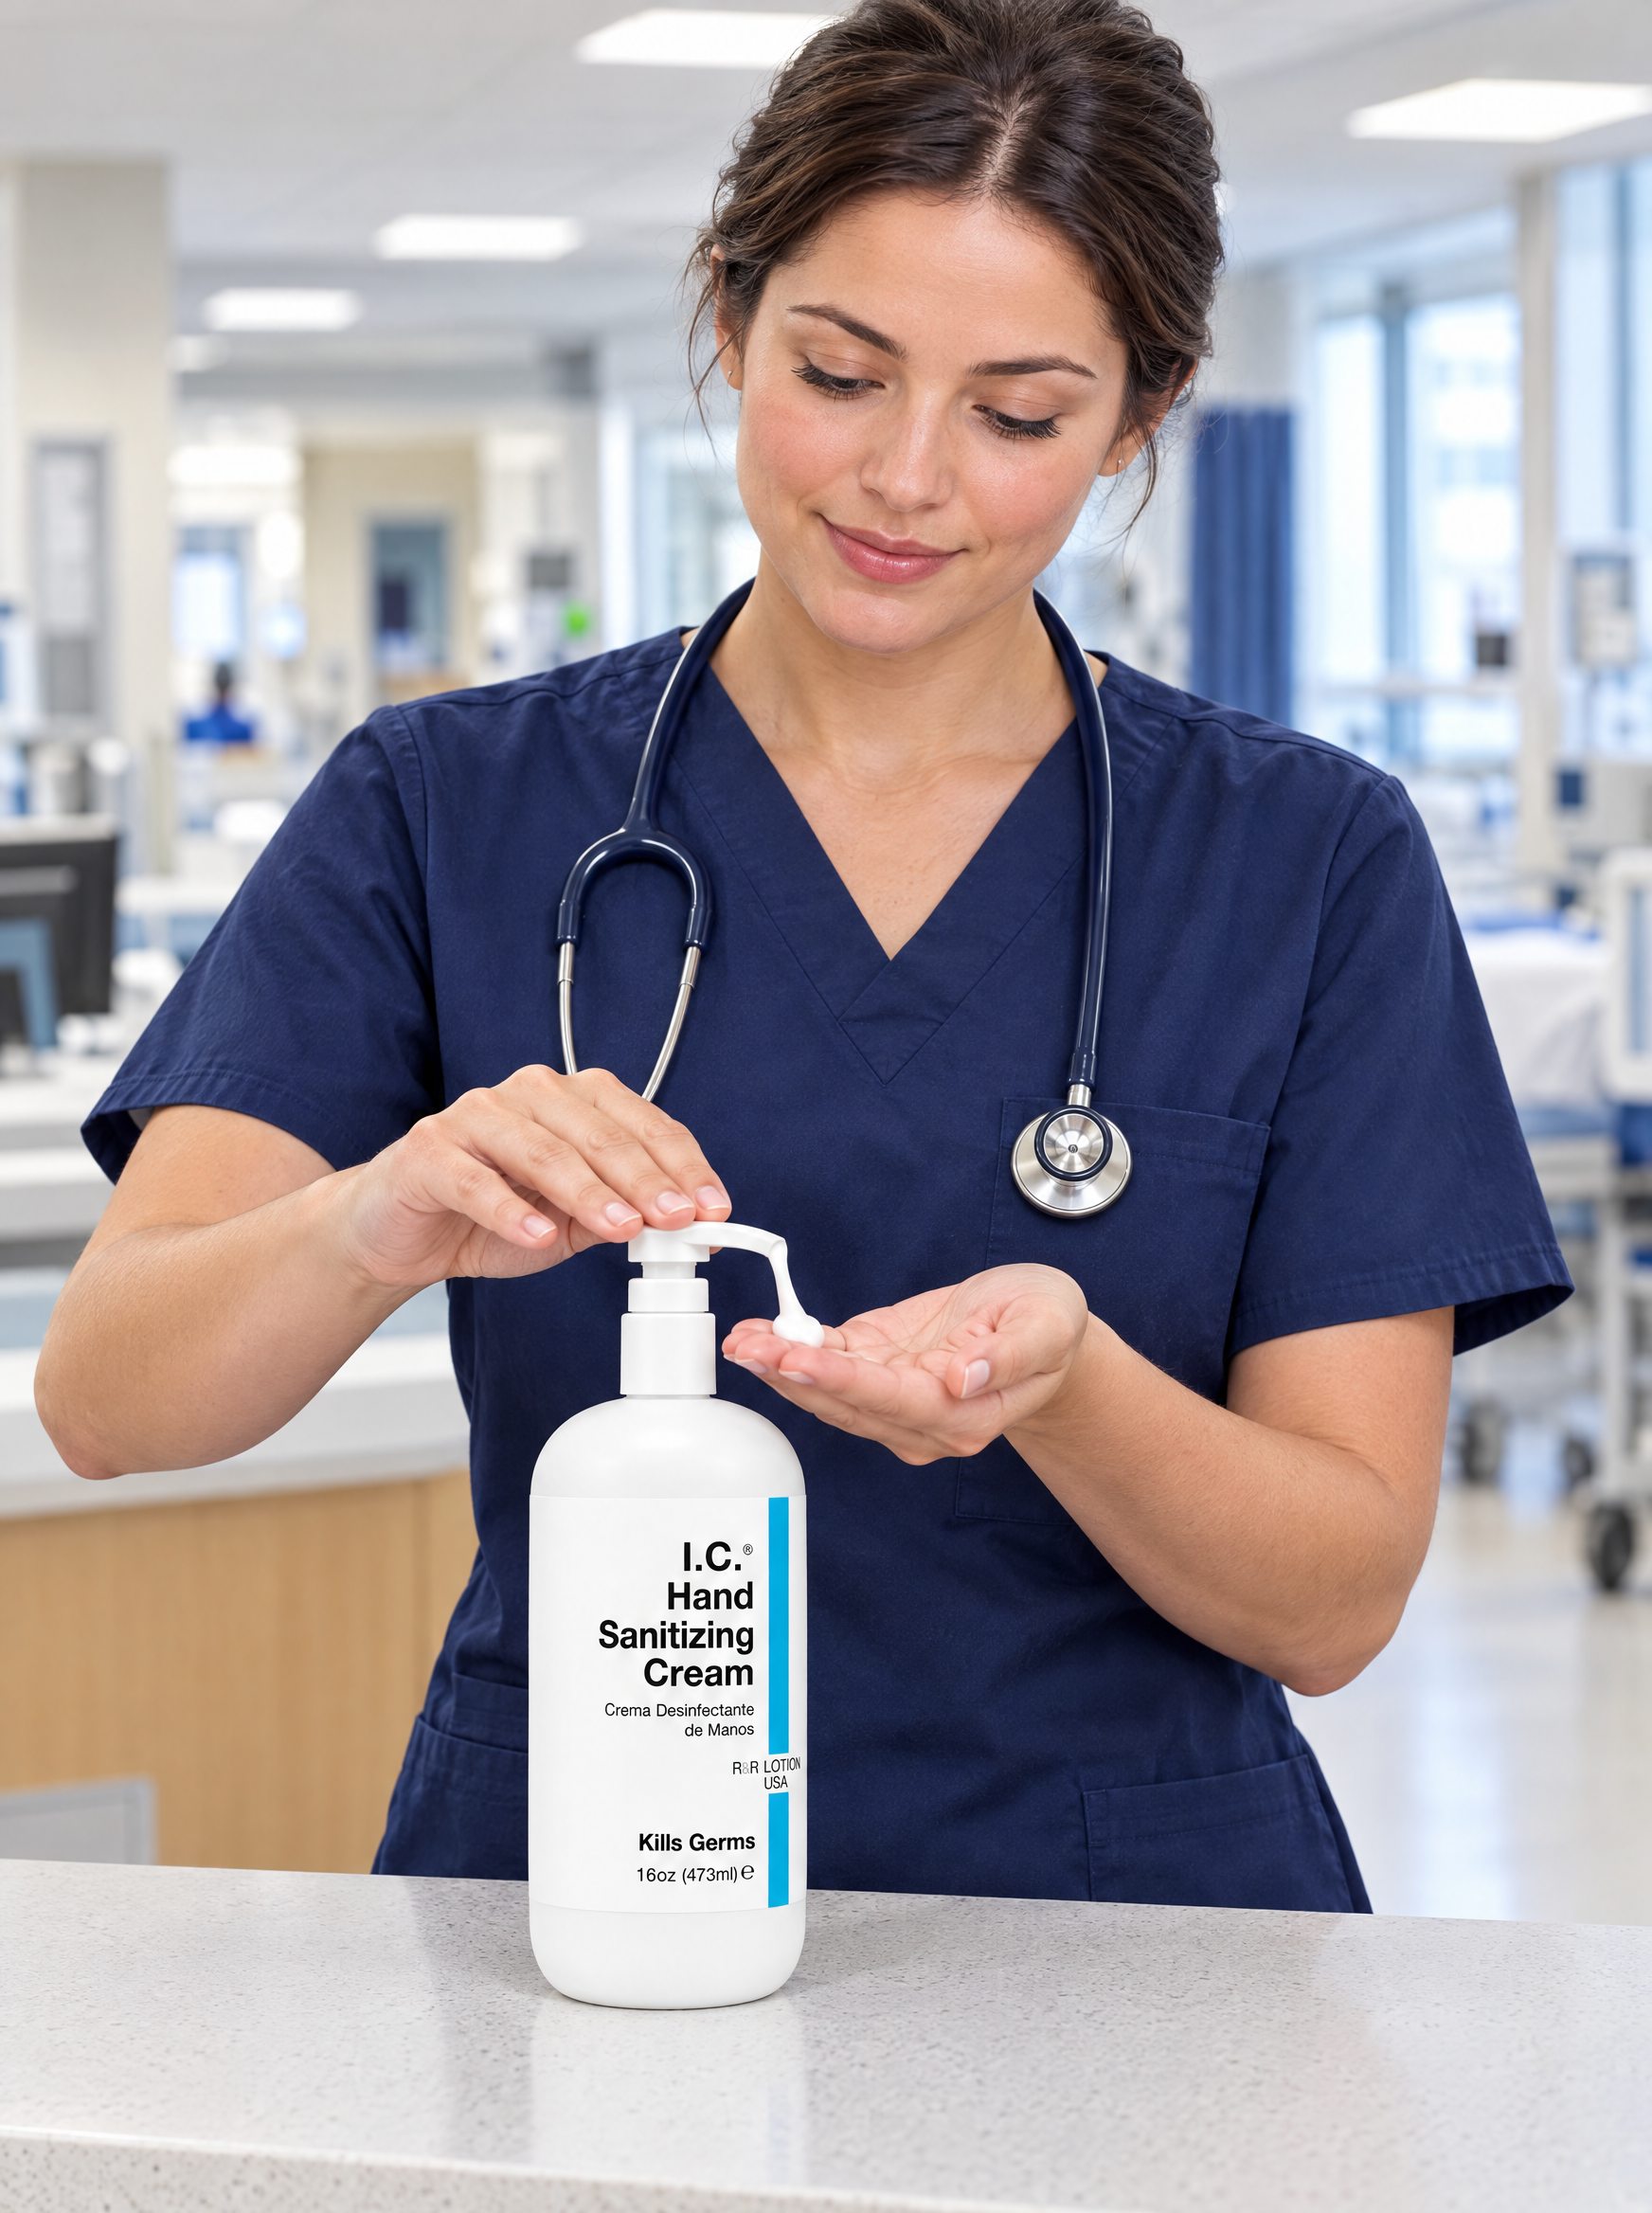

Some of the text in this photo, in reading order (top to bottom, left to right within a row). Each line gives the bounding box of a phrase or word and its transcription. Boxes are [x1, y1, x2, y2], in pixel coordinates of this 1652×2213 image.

[668, 1581, 754, 1610] Hand
[599, 1620, 754, 1655] Sanitizing
[643, 1658, 754, 1687] Cream
[604, 1702, 755, 1718] Crema Desinfectante
[684, 1723, 755, 1737] de Manos
[732, 1756, 801, 1774] R&R LOTION
[763, 1775, 788, 1790] USA
[638, 1832, 756, 1852] Kills Germs
[637, 1867, 676, 1882] 16oz
[682, 1866, 738, 1885] (473ml)
